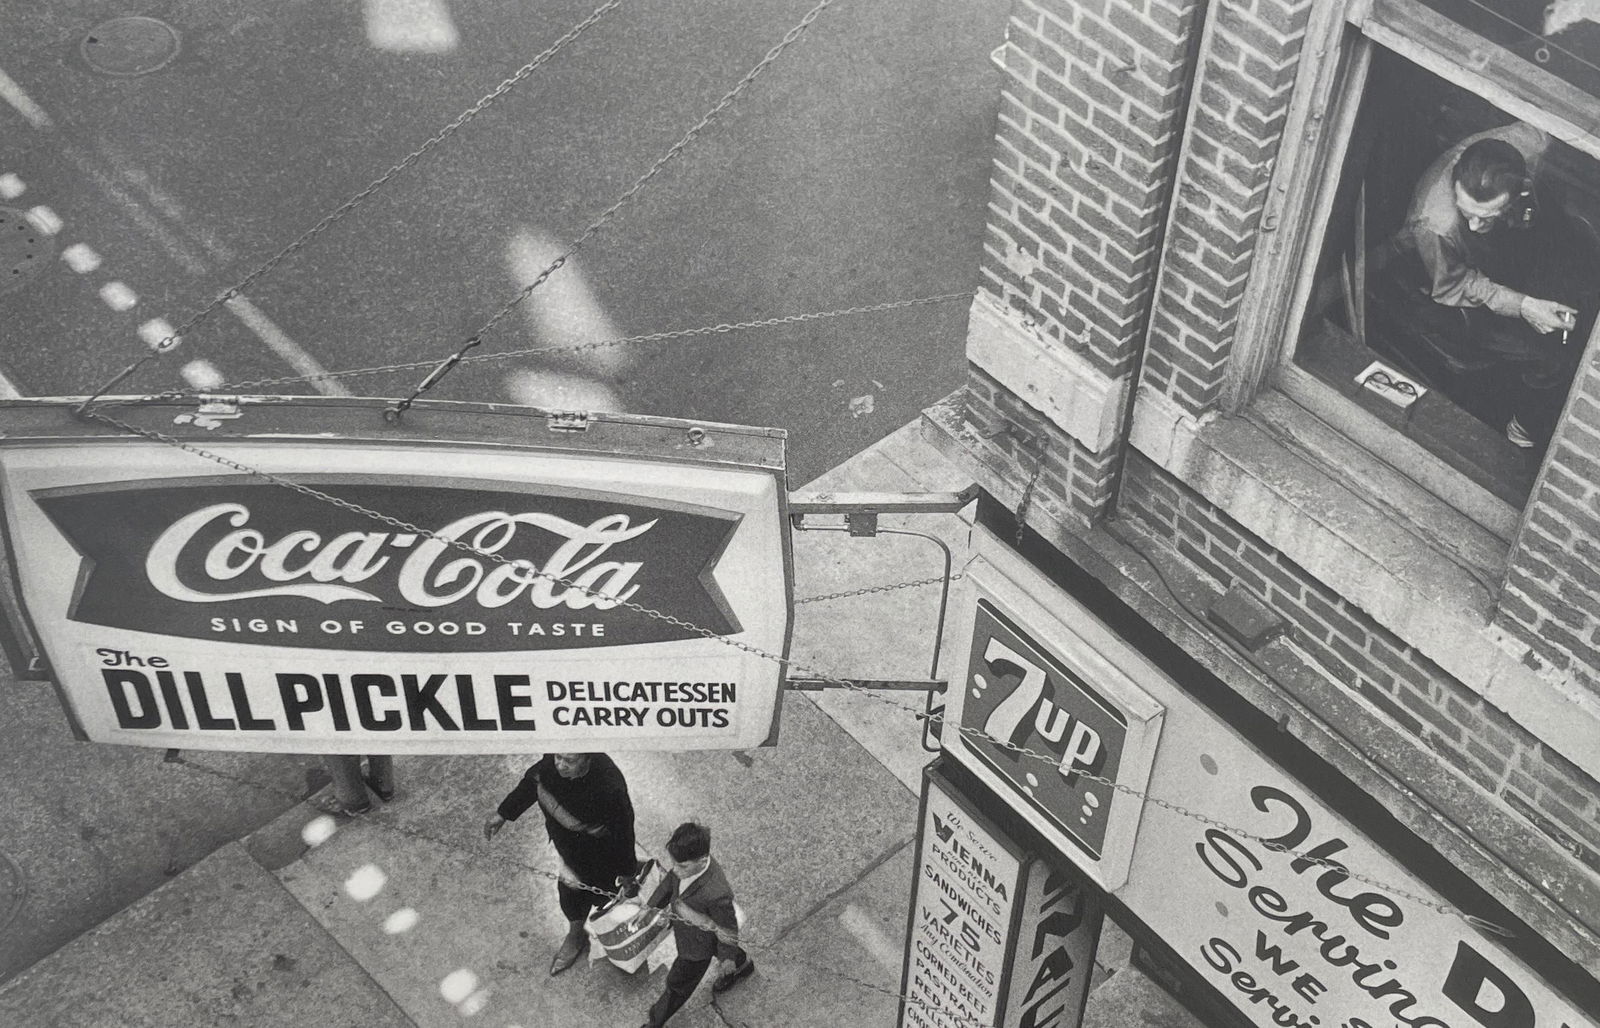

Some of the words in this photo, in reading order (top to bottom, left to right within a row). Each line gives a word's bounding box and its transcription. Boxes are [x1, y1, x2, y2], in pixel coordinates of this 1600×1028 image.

[145, 502, 658, 610] Coca-Cola
[96, 648, 170, 669] The
[210, 615, 298, 635] SIGN
[320, 618, 365, 636] OF
[387, 620, 487, 638] GOOD
[508, 622, 607, 639] TASTE
[101, 668, 276, 730] DILL
[276, 673, 536, 731] PICKLE
[547, 681, 738, 704] DELICATESSEN
[551, 707, 648, 728] CARRY
[659, 708, 730, 729] OUTS
[932, 812, 1008, 903] VIENNA
[932, 843, 1001, 916] PRODUCTS
[925, 864, 1002, 946] SANDWICHES
[940, 896, 981, 953] 75
[1195, 828, 1451, 1028] Servin
[1250, 785, 1404, 940] The
[1442, 940, 1571, 1028] D
[916, 940, 958, 987] CORNED
[959, 983, 988, 1015] BEEF
[922, 905, 995, 986] VARIETIES
[1255, 929, 1328, 1005] WE
[911, 990, 948, 1028] ROLLE
[914, 975, 941, 1007] RED
[916, 958, 985, 1028] PASTRAM
